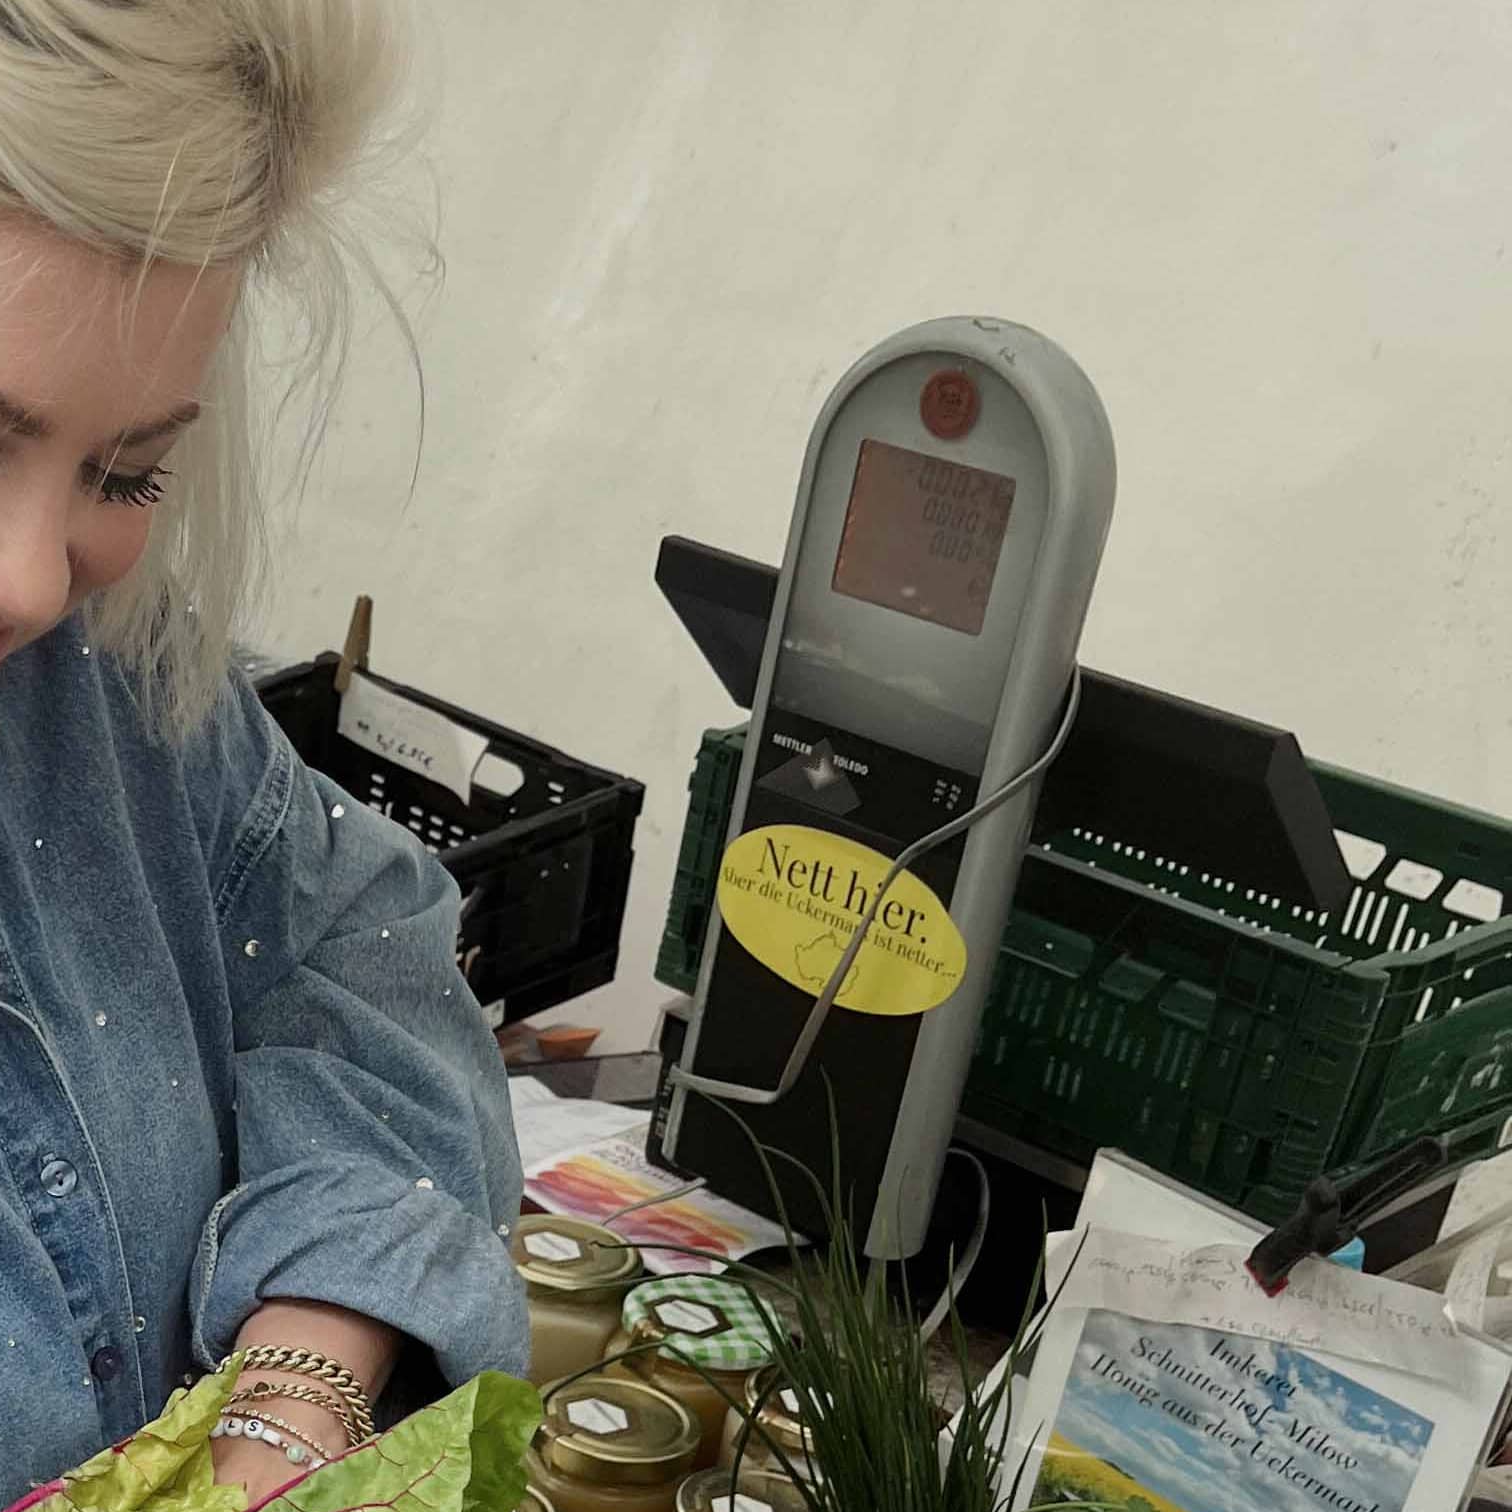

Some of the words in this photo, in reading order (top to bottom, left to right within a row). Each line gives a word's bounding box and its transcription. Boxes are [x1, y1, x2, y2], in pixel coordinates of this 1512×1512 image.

[772, 733, 813, 756] METTLER
[832, 754, 869, 776] TOLEDO
[755, 837, 840, 903] Nett
[759, 879, 784, 901] die
[873, 928, 897, 952] ist
[1209, 1338, 1299, 1398] Imkerei
[1089, 1353, 1161, 1405] Honig
[1162, 1398, 1200, 1428] aus
[1203, 1418, 1246, 1450] der
[1288, 1418, 1359, 1470] Milow
